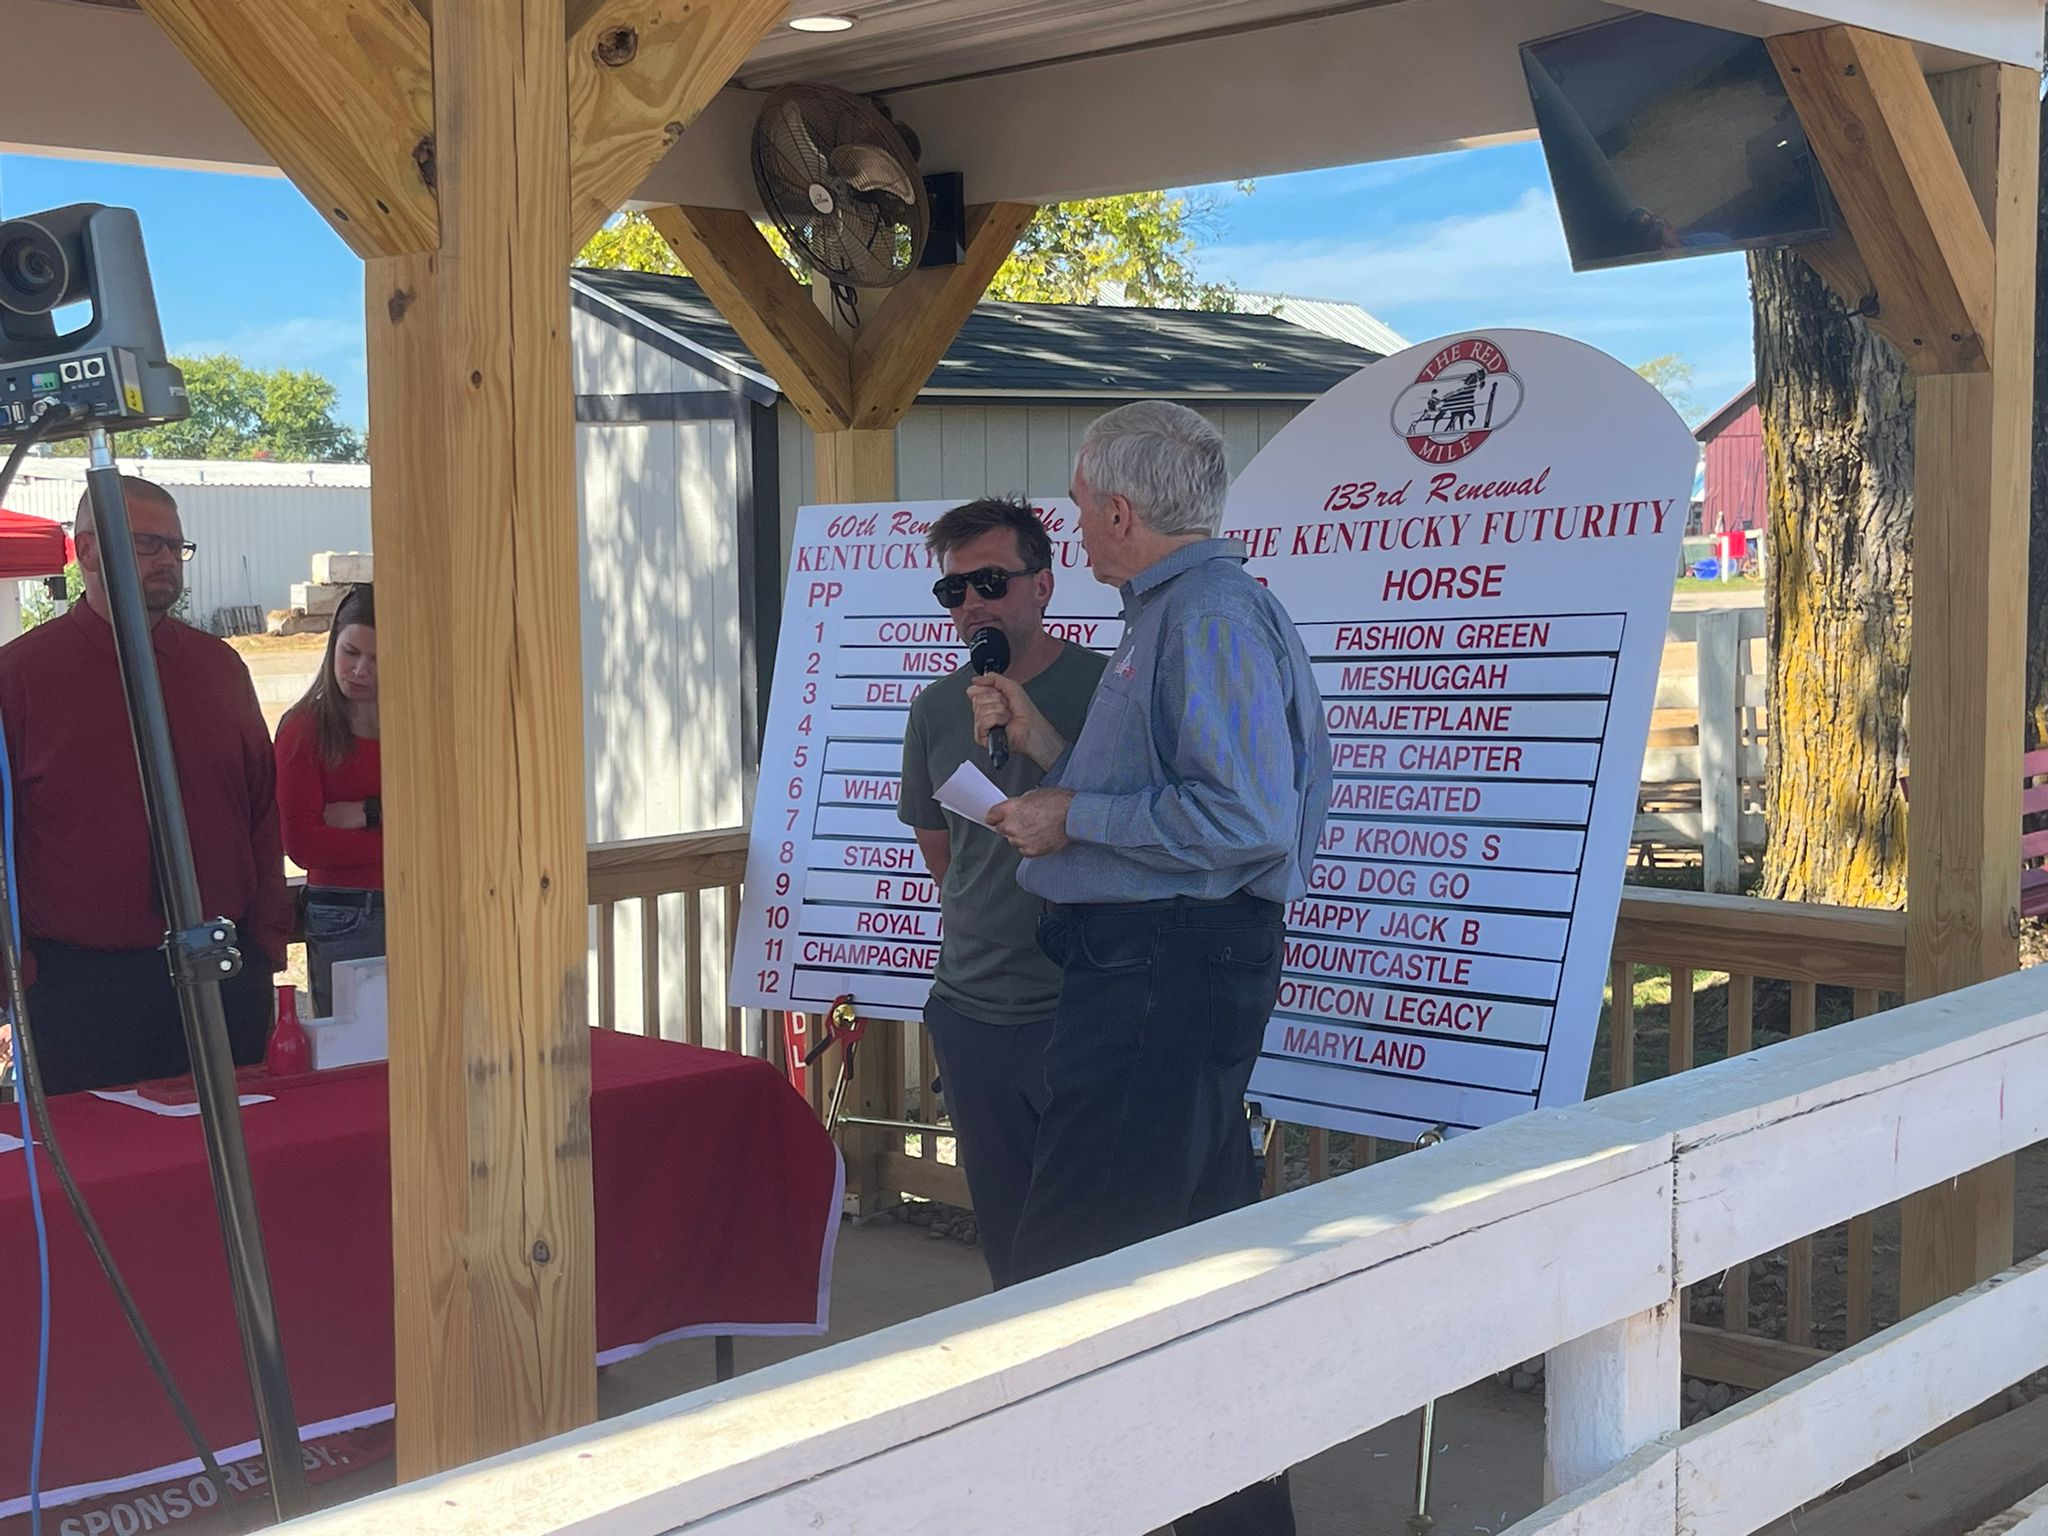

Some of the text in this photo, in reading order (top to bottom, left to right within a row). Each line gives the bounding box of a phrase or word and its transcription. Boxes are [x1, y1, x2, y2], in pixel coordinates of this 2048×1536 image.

[1422, 342, 1502, 379] THE RED
[1419, 436, 1472, 462] MILE
[1322, 466, 1552, 512] 133rd Renewal
[827, 512, 879, 538] 60th
[888, 511, 930, 536] Ren
[1288, 513, 1472, 556] KENTUCKY
[1480, 497, 1677, 545] FUTURITY
[807, 581, 843, 608] PP
[1381, 564, 1506, 602] HORSE
[814, 621, 825, 644] 1
[878, 622, 960, 643] COUNT
[1334, 621, 1551, 651] FASHION GREEN
[804, 651, 960, 675] 2 MISS
[1340, 664, 1508, 692] MESHUGGAH
[801, 682, 925, 705] 3 DELA
[797, 713, 813, 737] 4
[1326, 704, 1513, 732] ONAJETPLANE
[792, 746, 809, 769] 5
[1398, 743, 1524, 773] CHAPTER
[787, 776, 804, 800] 6
[786, 809, 800, 832] 7
[779, 840, 914, 869] 8 STASH
[1354, 827, 1468, 860] KRONOS
[1481, 833, 1501, 862] S
[775, 872, 791, 896] 9
[876, 879, 892, 901] R
[1310, 863, 1470, 900] GO DOG GO
[765, 905, 790, 930] 10
[856, 911, 926, 936] ROYAL
[1287, 901, 1481, 946] HAPPY JACK B
[764, 938, 939, 970] 11 CHAMPAGNE
[1283, 941, 1474, 987] MOUNTCASTLE
[757, 970, 780, 994] 12
[1276, 981, 1494, 1034] OTICON LEGACY
[1283, 1026, 1427, 1072] MARYLAND
[60, 1460, 267, 1536] SPONSORE
